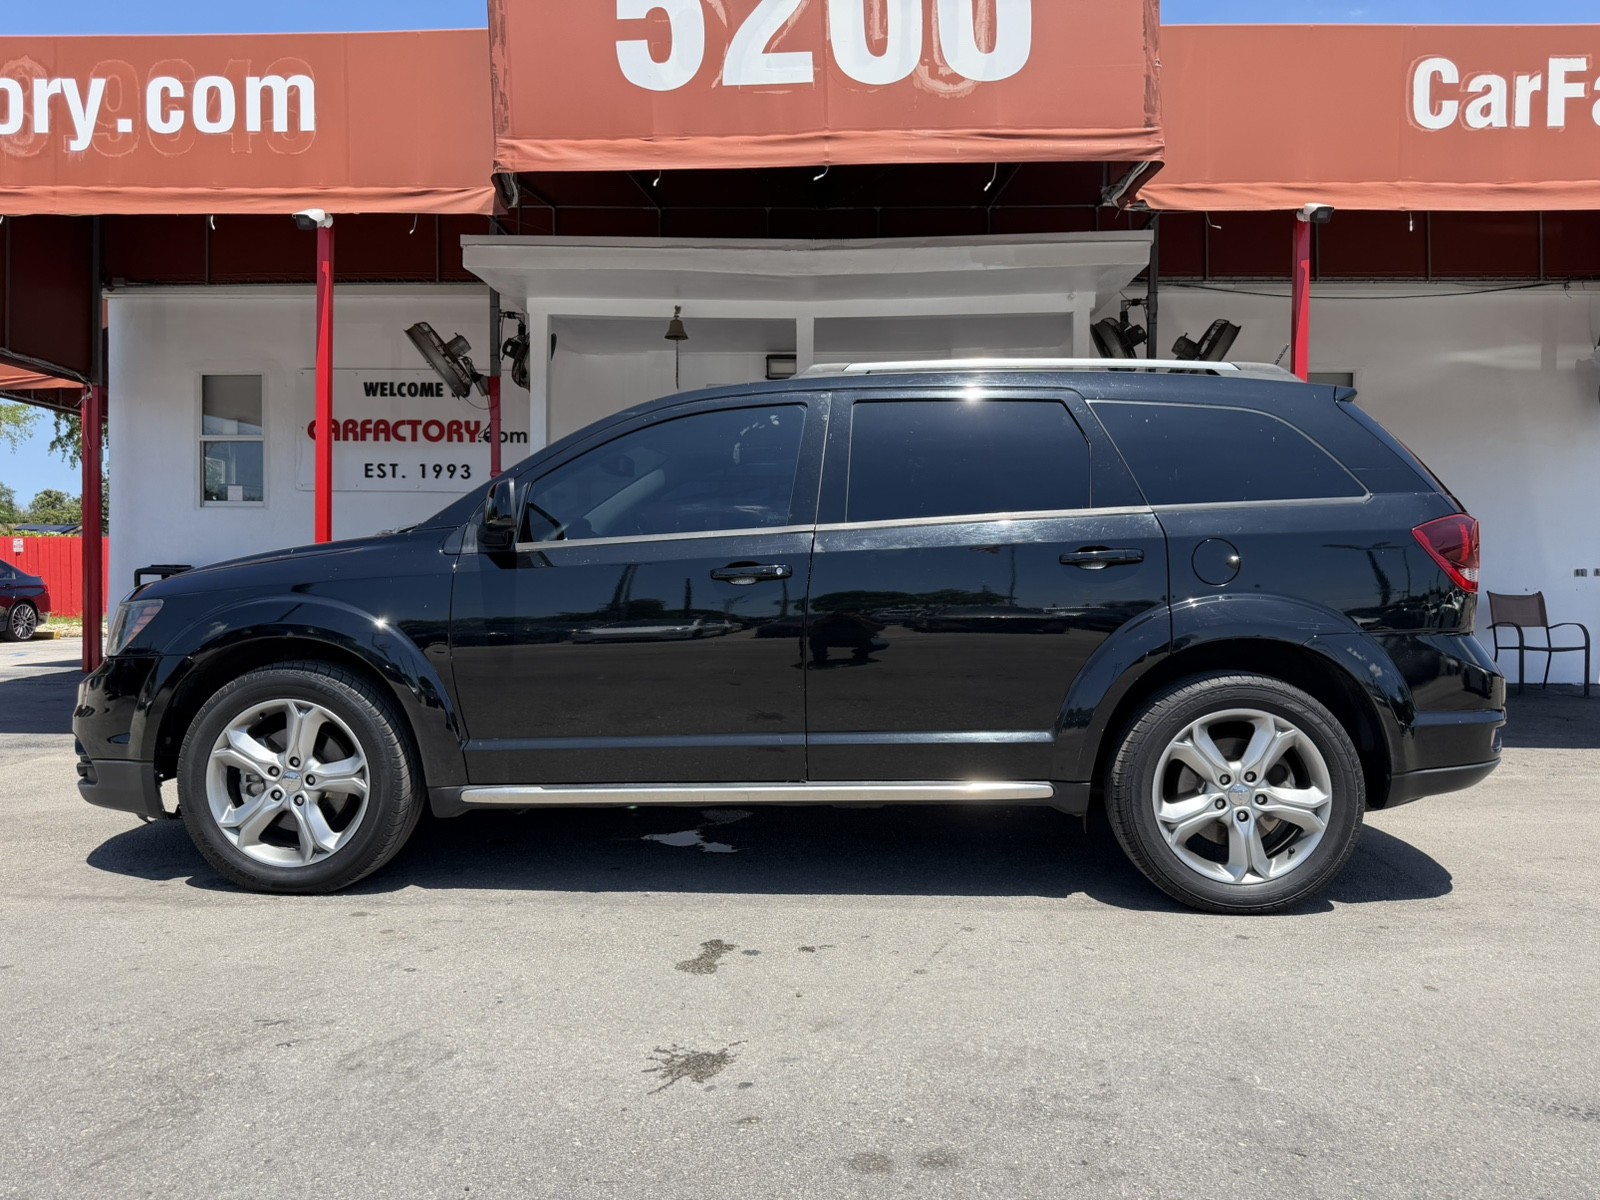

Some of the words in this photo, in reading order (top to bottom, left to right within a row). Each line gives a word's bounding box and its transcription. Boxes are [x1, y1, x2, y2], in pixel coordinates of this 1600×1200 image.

[615, 0, 1033, 91] 5200
[1413, 57, 1600, 129] CarF
[363, 381, 444, 397] WELCOME
[364, 463, 406, 479] EST.
[419, 463, 472, 479] 1993
